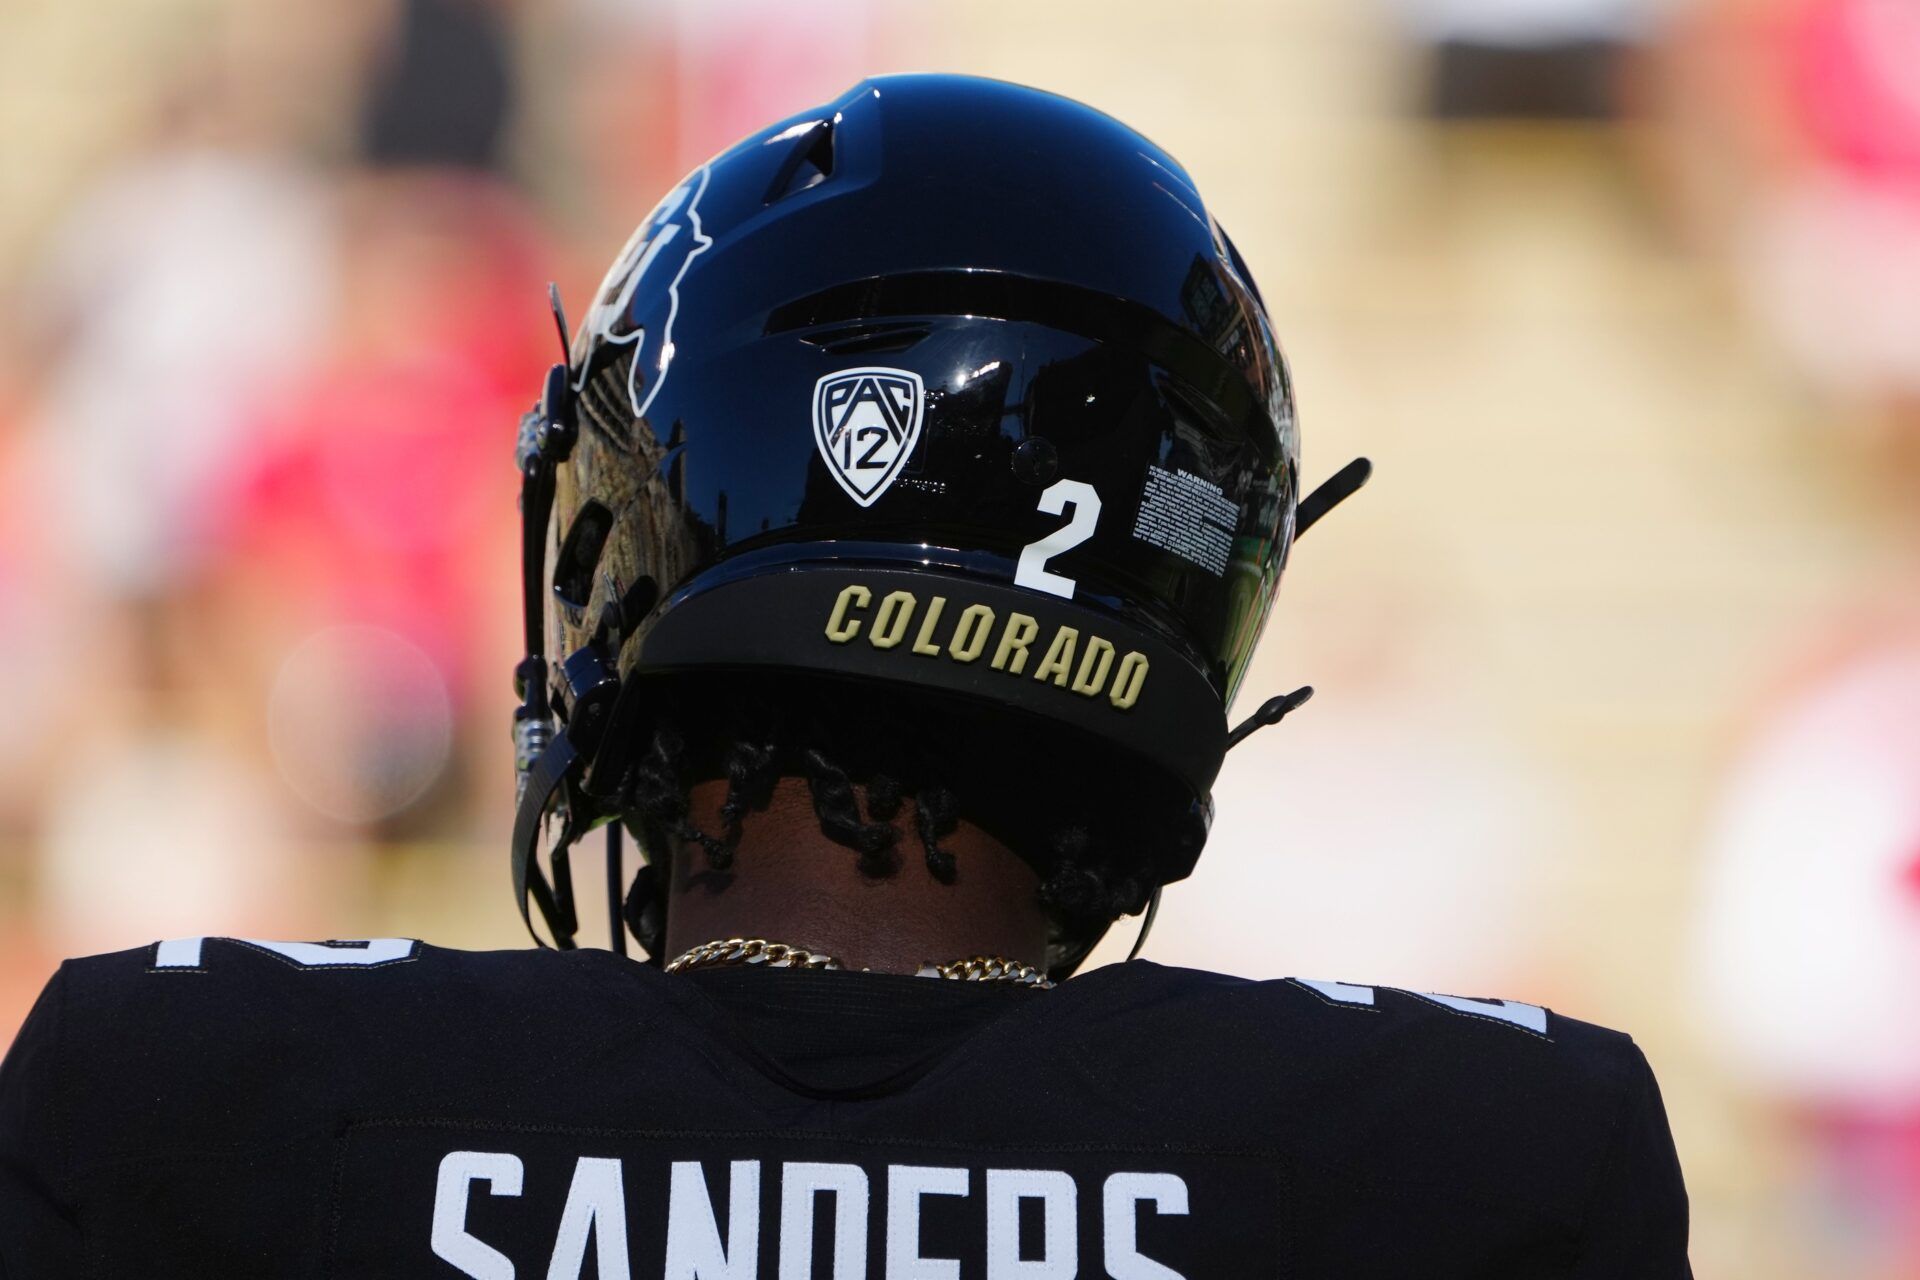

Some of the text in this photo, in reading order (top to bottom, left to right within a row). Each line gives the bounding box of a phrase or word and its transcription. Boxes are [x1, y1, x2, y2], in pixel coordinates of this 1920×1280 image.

[825, 378, 911, 449] PAC
[844, 426, 889, 470] 12
[1177, 468, 1225, 496] WARNING
[1013, 478, 1102, 600] 2
[824, 585, 1149, 710] COLORADO
